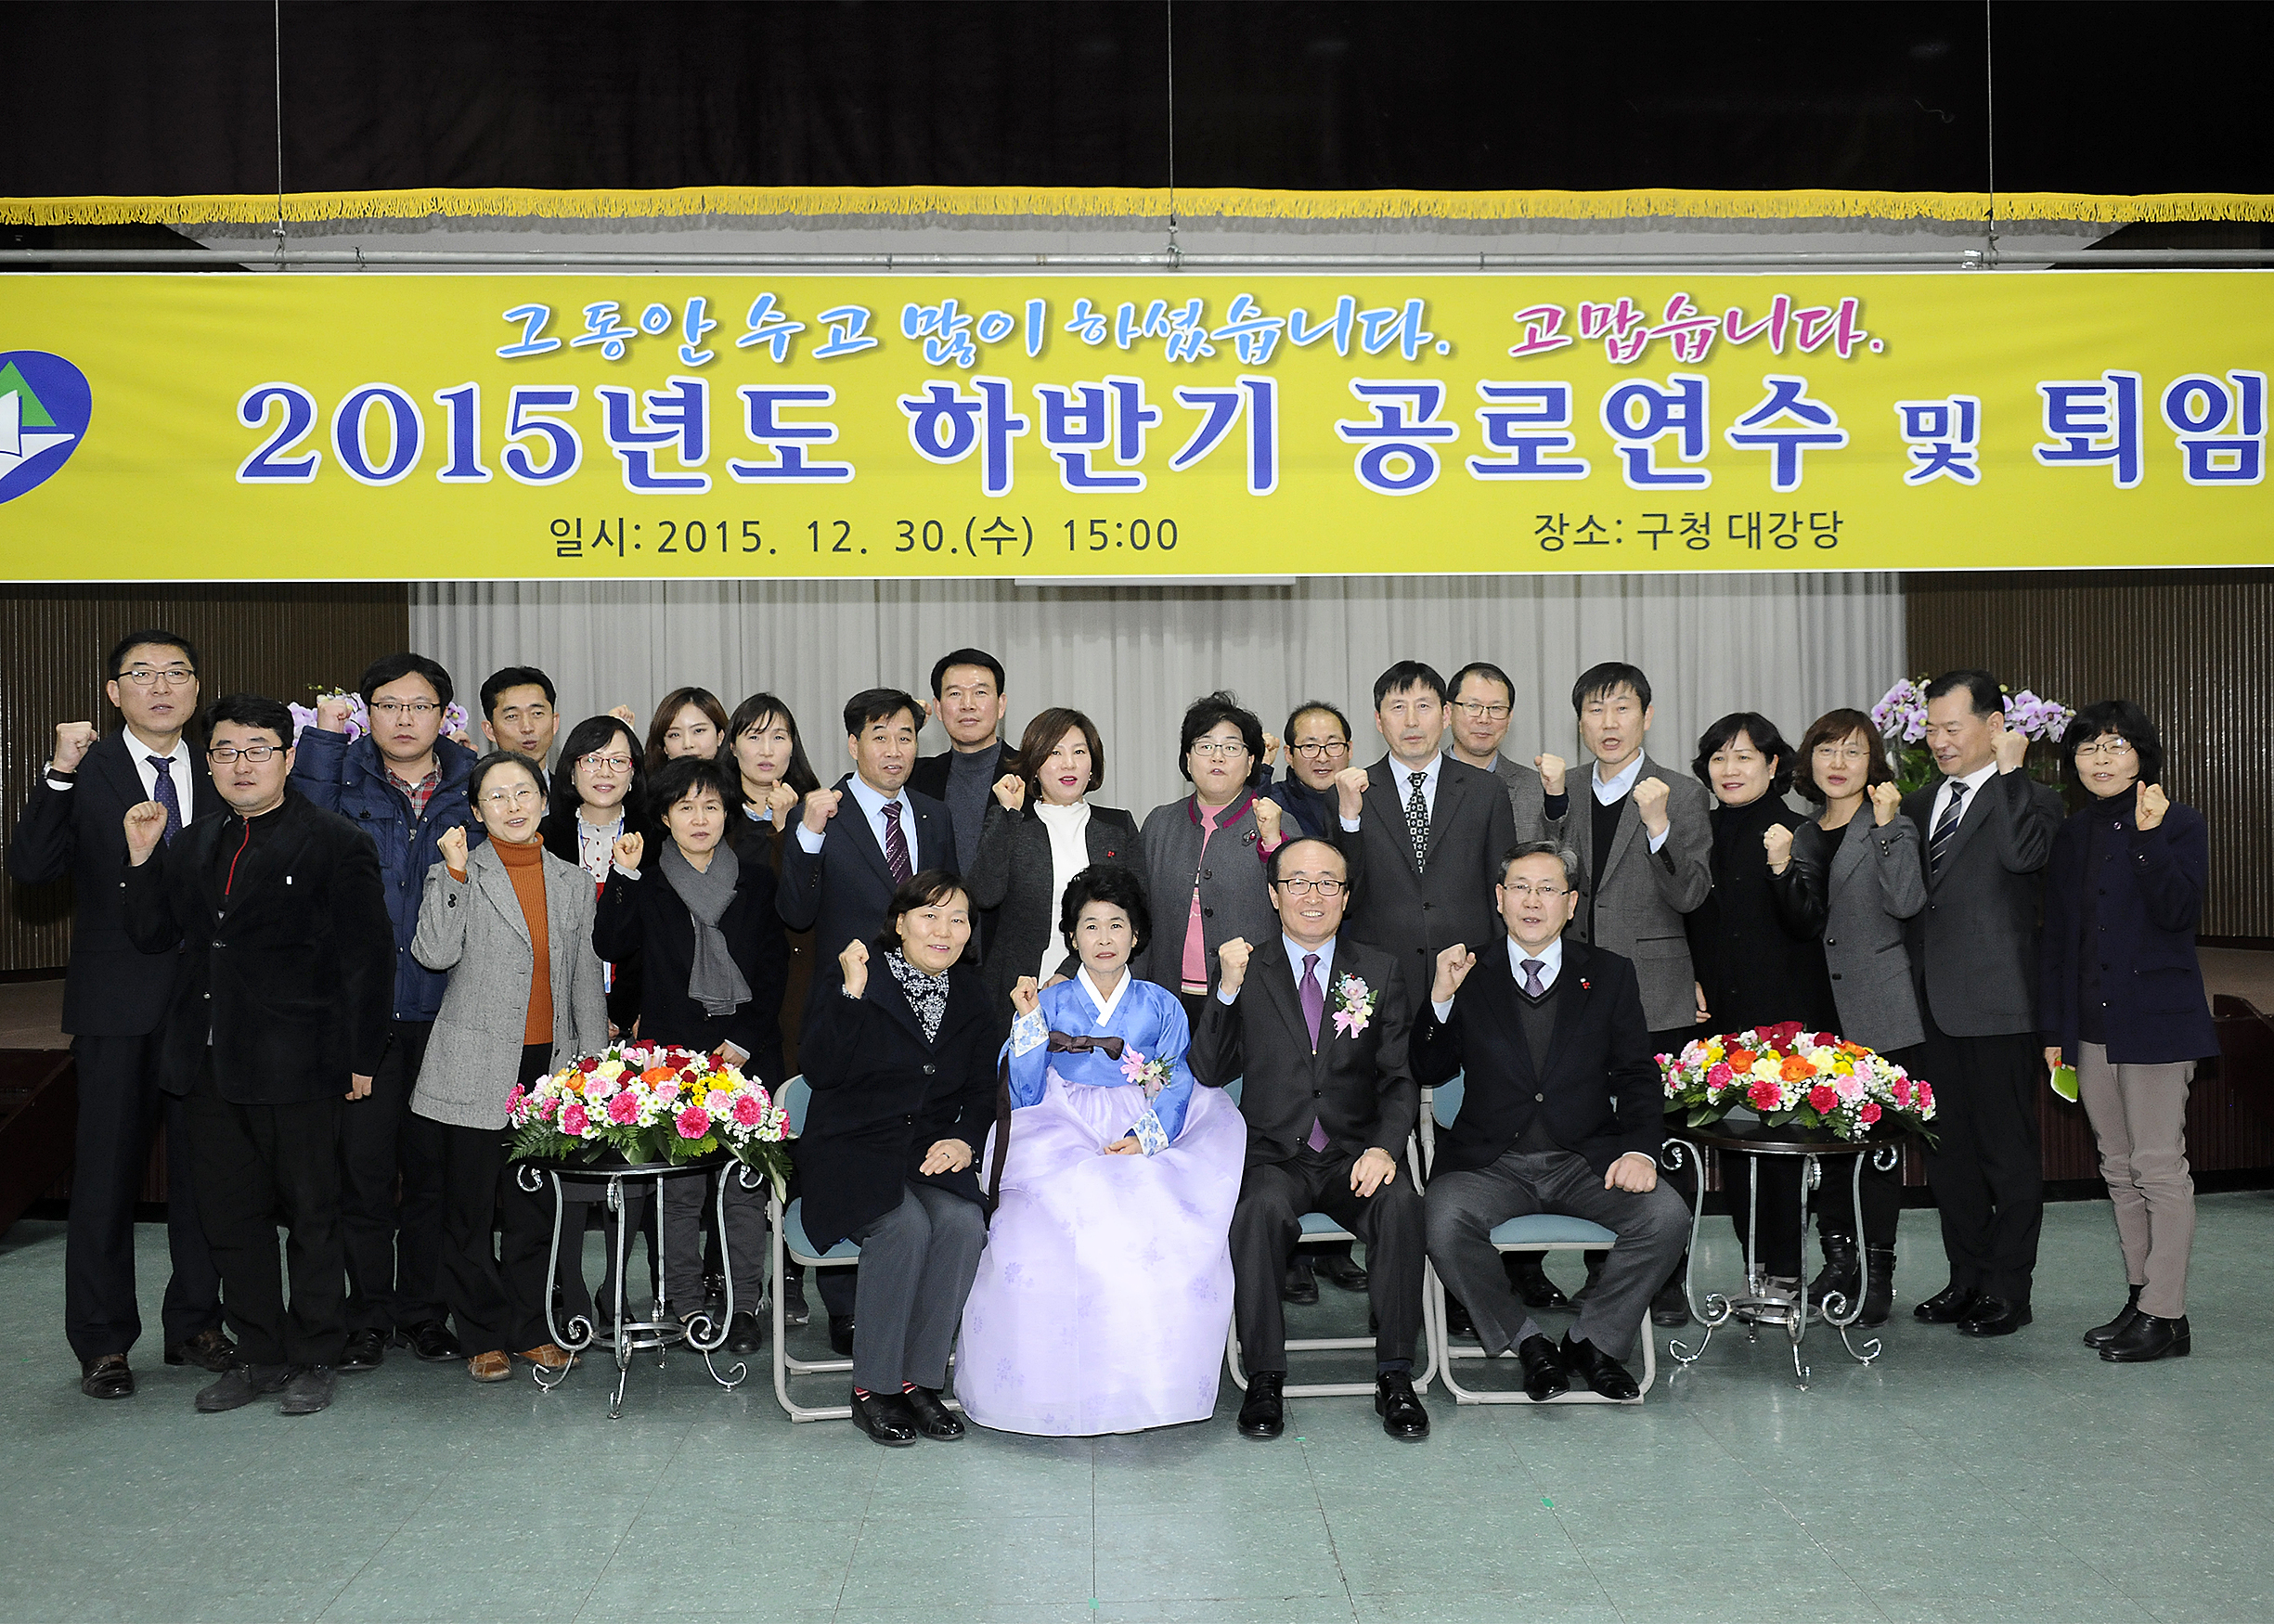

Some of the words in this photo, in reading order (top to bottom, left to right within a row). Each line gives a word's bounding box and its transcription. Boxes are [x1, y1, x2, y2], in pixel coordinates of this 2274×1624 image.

[496, 296, 717, 367] 그동안
[735, 292, 878, 363] 수고
[900, 298, 1046, 368] 많이
[1064, 293, 1450, 365] 하셨습니다.
[1508, 292, 1884, 364] 고맙습니다.
[236, 375, 856, 495] 2015년도
[896, 374, 1279, 497] 하반기
[1334, 373, 1850, 496] 공로연수
[1893, 393, 1982, 486] 및
[2032, 368, 2268, 489] 퇴임
[549, 517, 641, 558] 일시:
[657, 520, 776, 555] 2015.
[807, 520, 867, 555] 12.
[1064, 518, 1178, 551] 15:00
[1534, 512, 1622, 552] 장소:
[1636, 511, 1711, 551] 구청
[1728, 510, 1844, 550] 대강당
